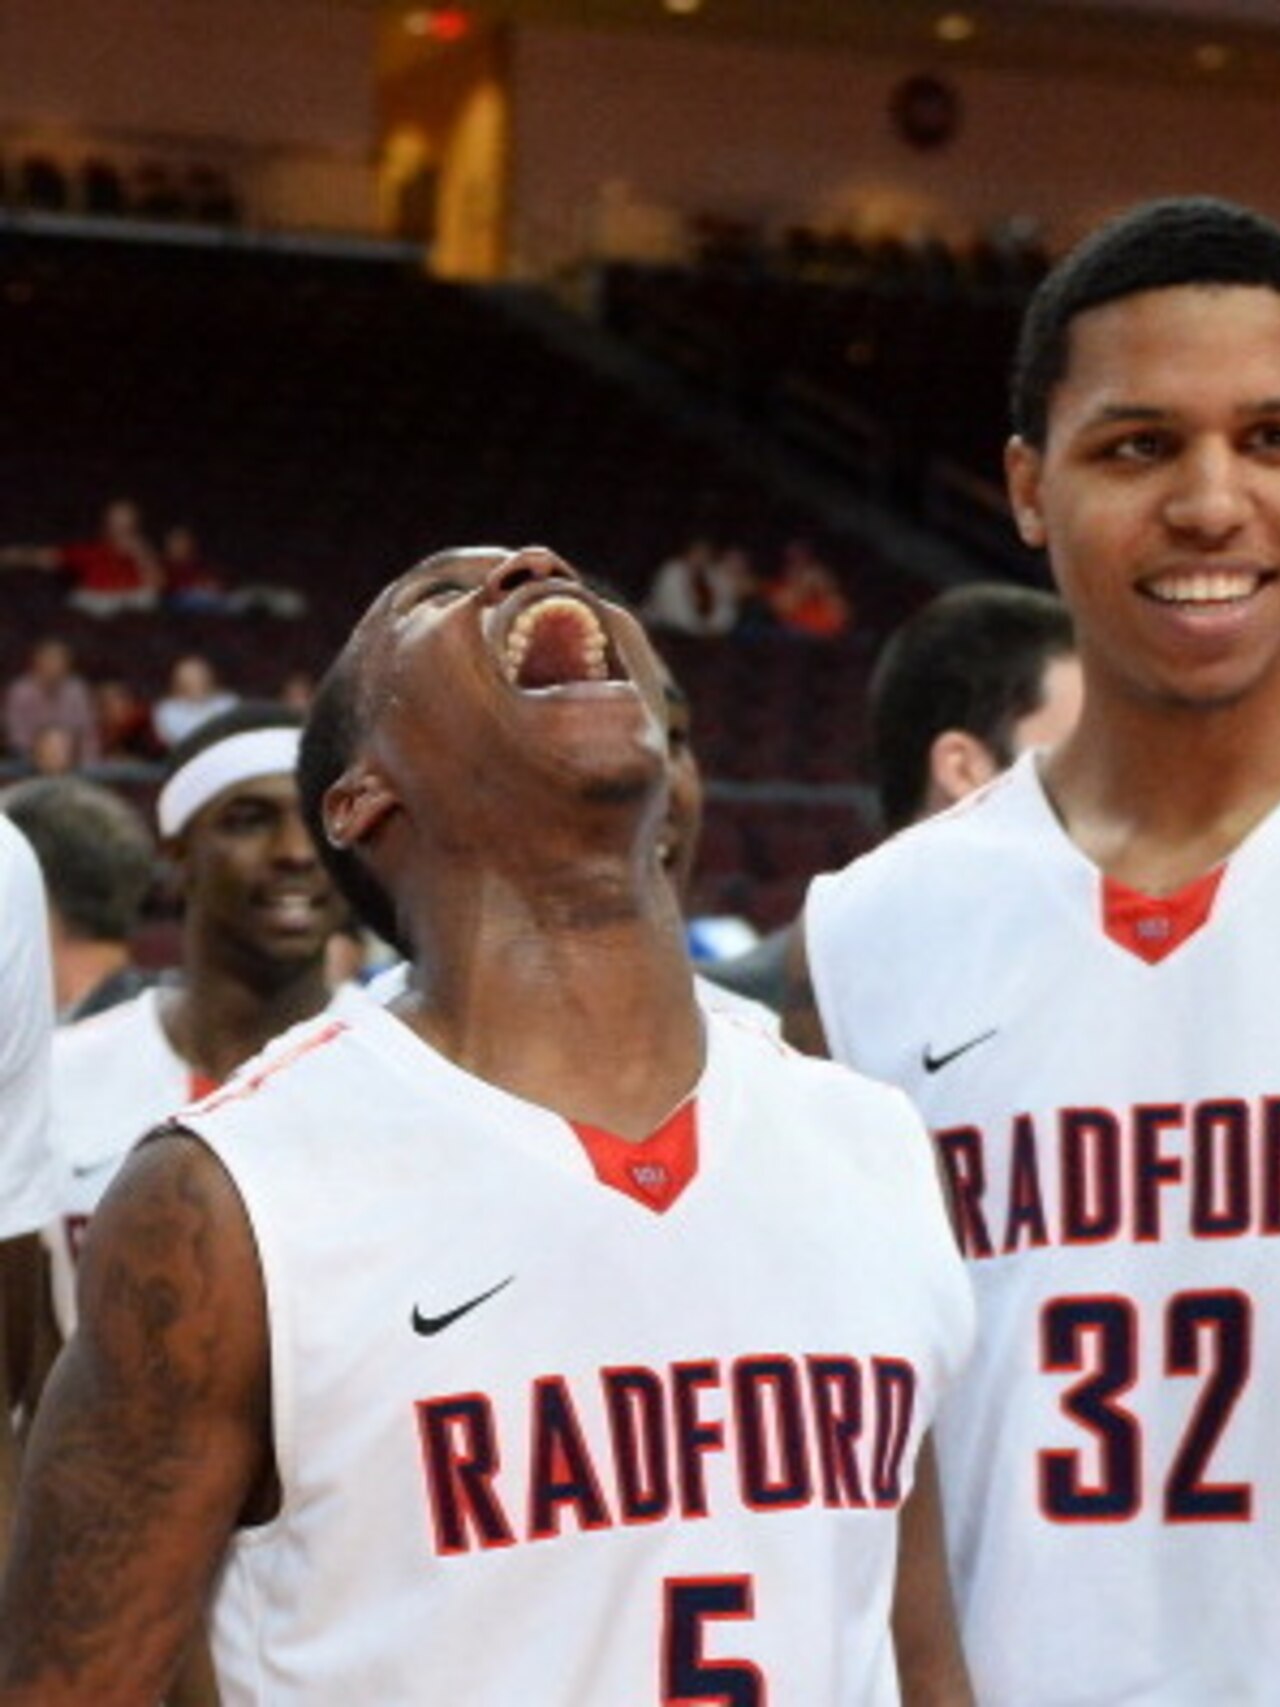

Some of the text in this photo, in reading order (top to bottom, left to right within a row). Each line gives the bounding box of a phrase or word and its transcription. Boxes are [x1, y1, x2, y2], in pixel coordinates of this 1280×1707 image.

[413, 1352, 916, 1556] RADFORD
[1037, 1287, 1254, 1524] 32
[659, 1573, 767, 1707] 5
